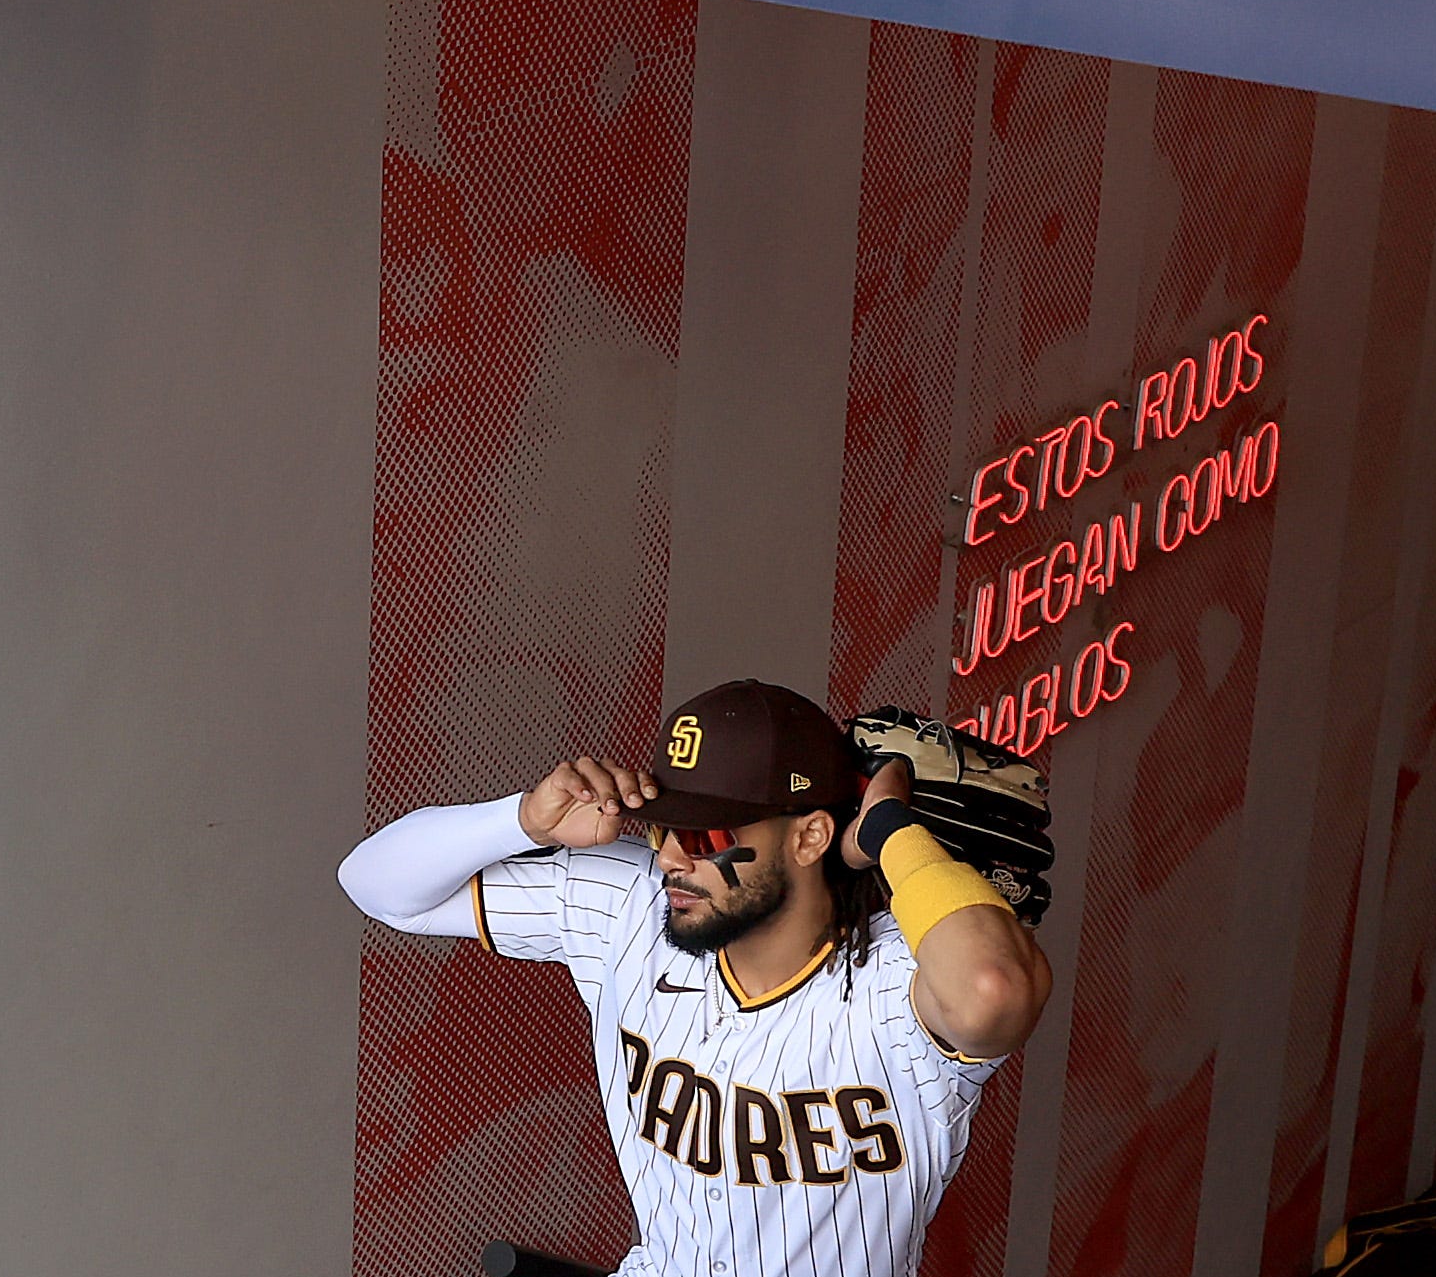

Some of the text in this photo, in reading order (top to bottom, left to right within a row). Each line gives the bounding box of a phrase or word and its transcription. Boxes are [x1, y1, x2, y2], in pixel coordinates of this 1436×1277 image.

[965, 315, 1268, 546] ESTOS ROJOS
[953, 422, 1279, 675] JUEGAN COMO
[620, 1026, 907, 1187] PADRES
